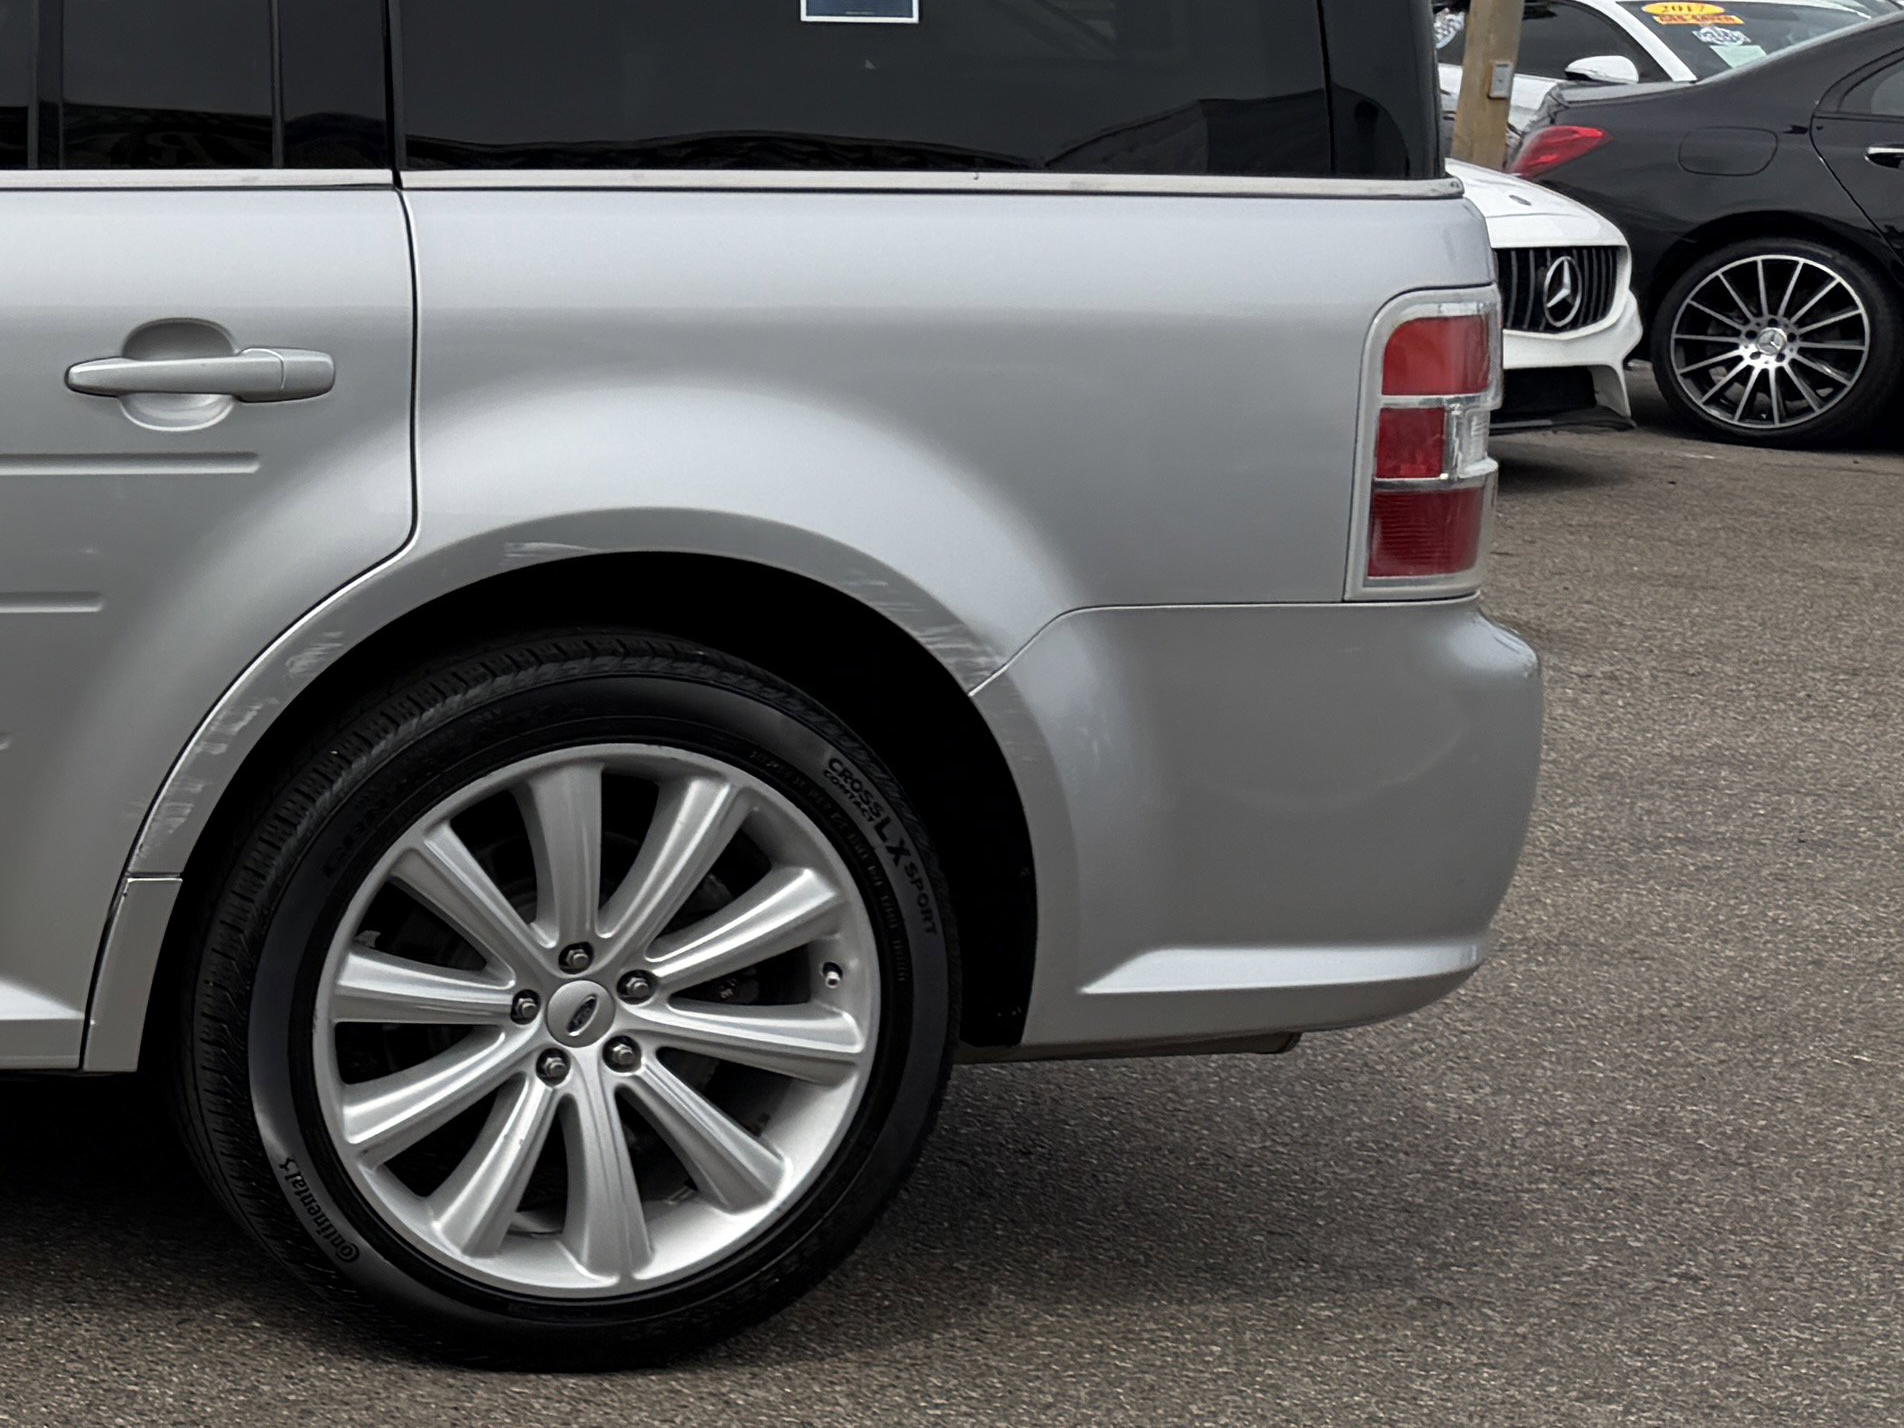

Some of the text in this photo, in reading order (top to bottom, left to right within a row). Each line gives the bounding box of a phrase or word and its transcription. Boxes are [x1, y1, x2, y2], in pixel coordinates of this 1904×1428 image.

[828, 757, 884, 819] CROSS
[904, 862, 937, 935] SPORT
[283, 1172, 360, 1263] Continental
